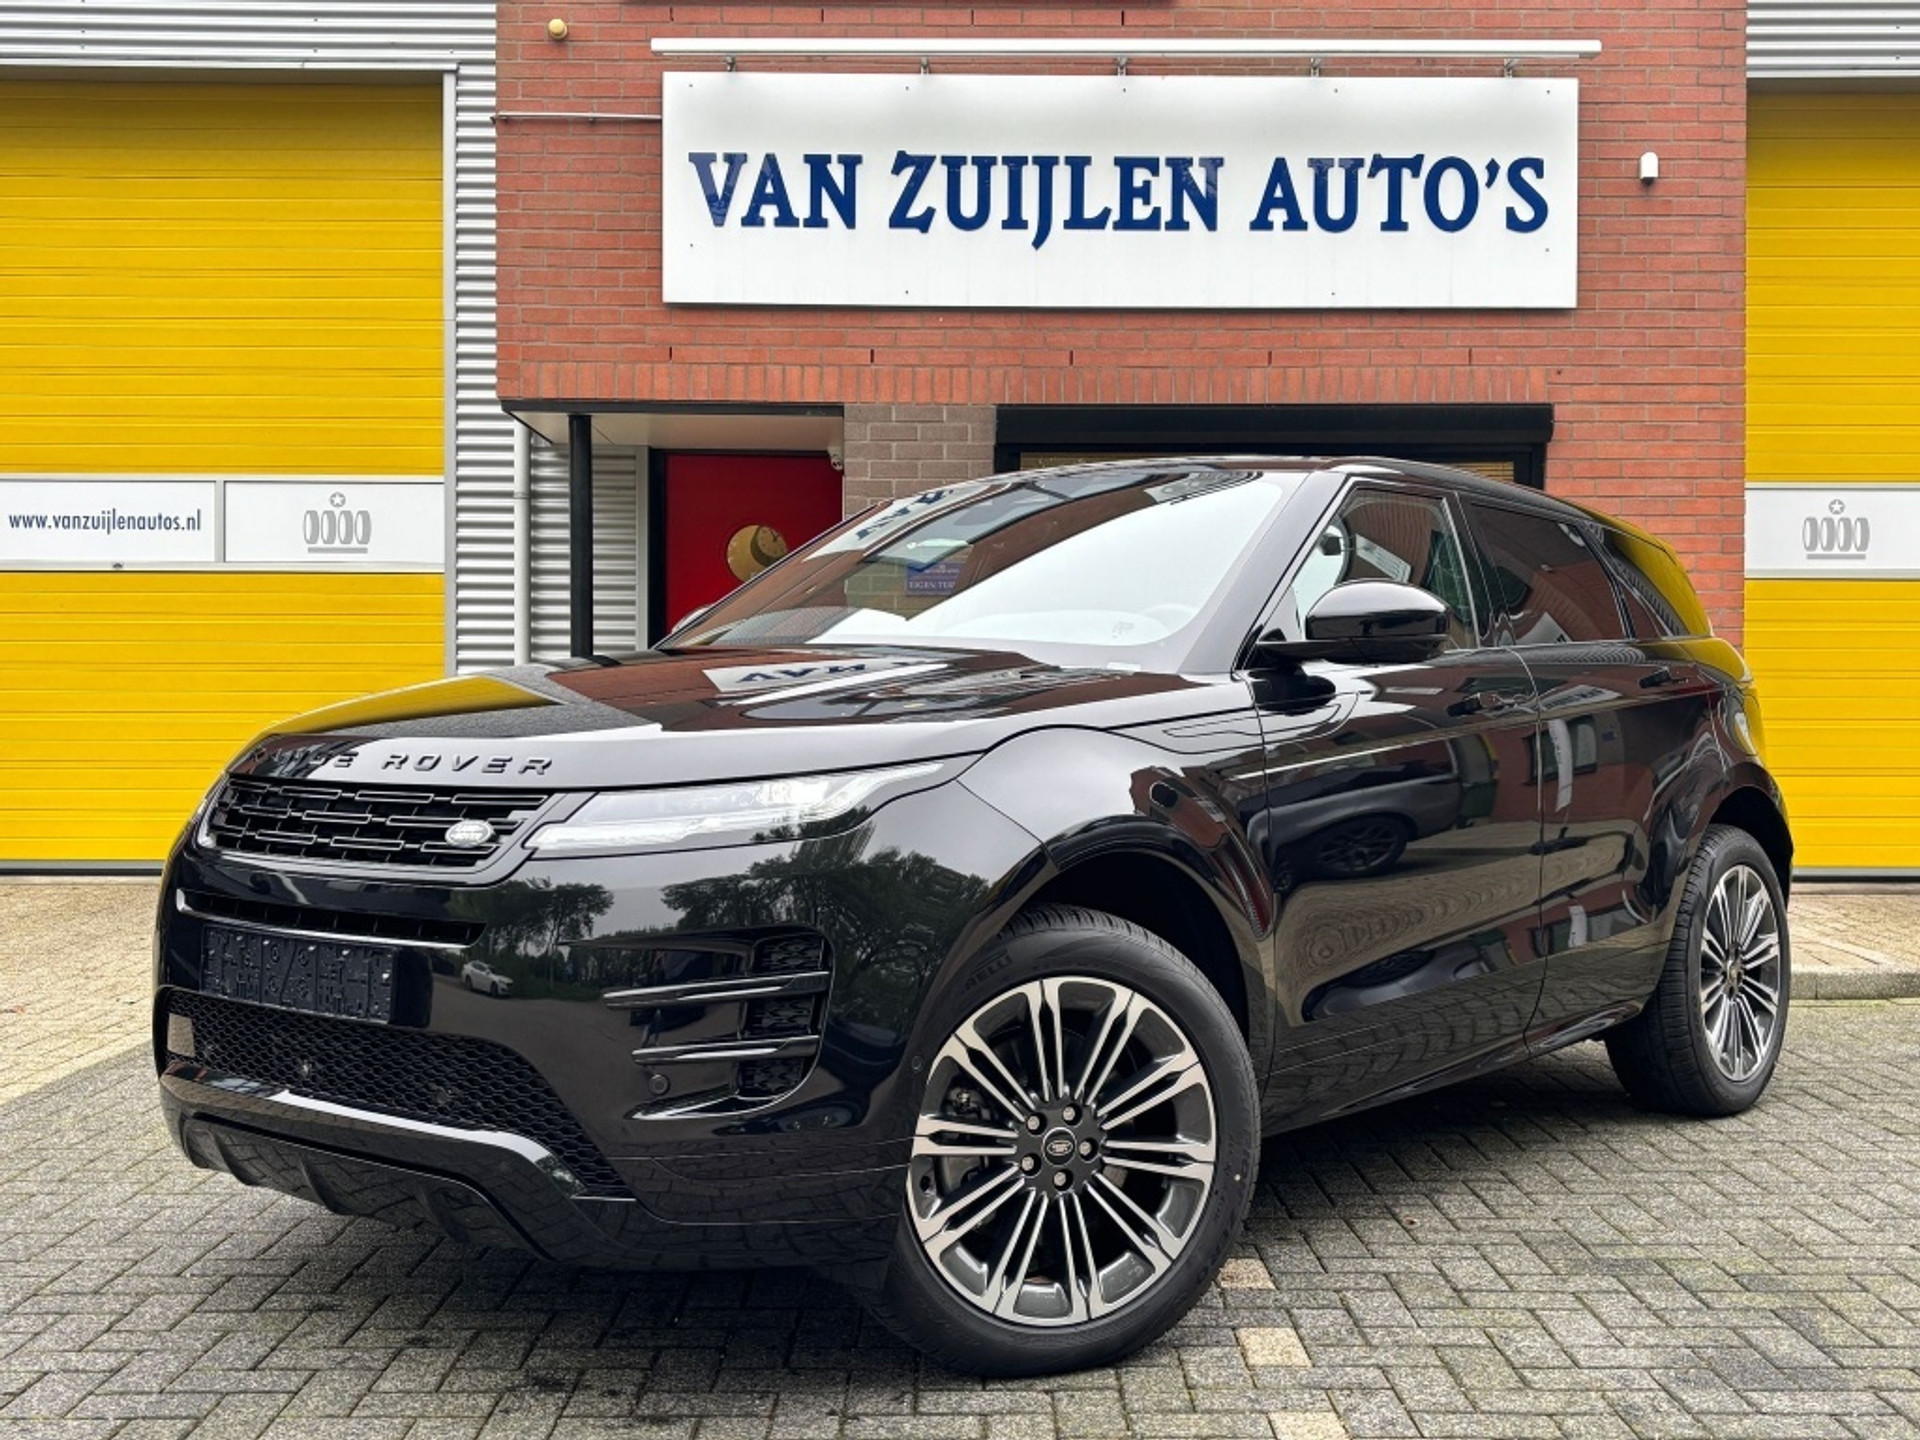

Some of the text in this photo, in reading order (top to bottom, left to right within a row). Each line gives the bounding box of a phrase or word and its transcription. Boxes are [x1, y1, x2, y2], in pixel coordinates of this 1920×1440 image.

[687, 150, 1549, 251] VAN ZUIJLEN AUTO'S
[9, 508, 201, 535] www.vanzuijlenautos.nl
[381, 754, 552, 776] ROVER
